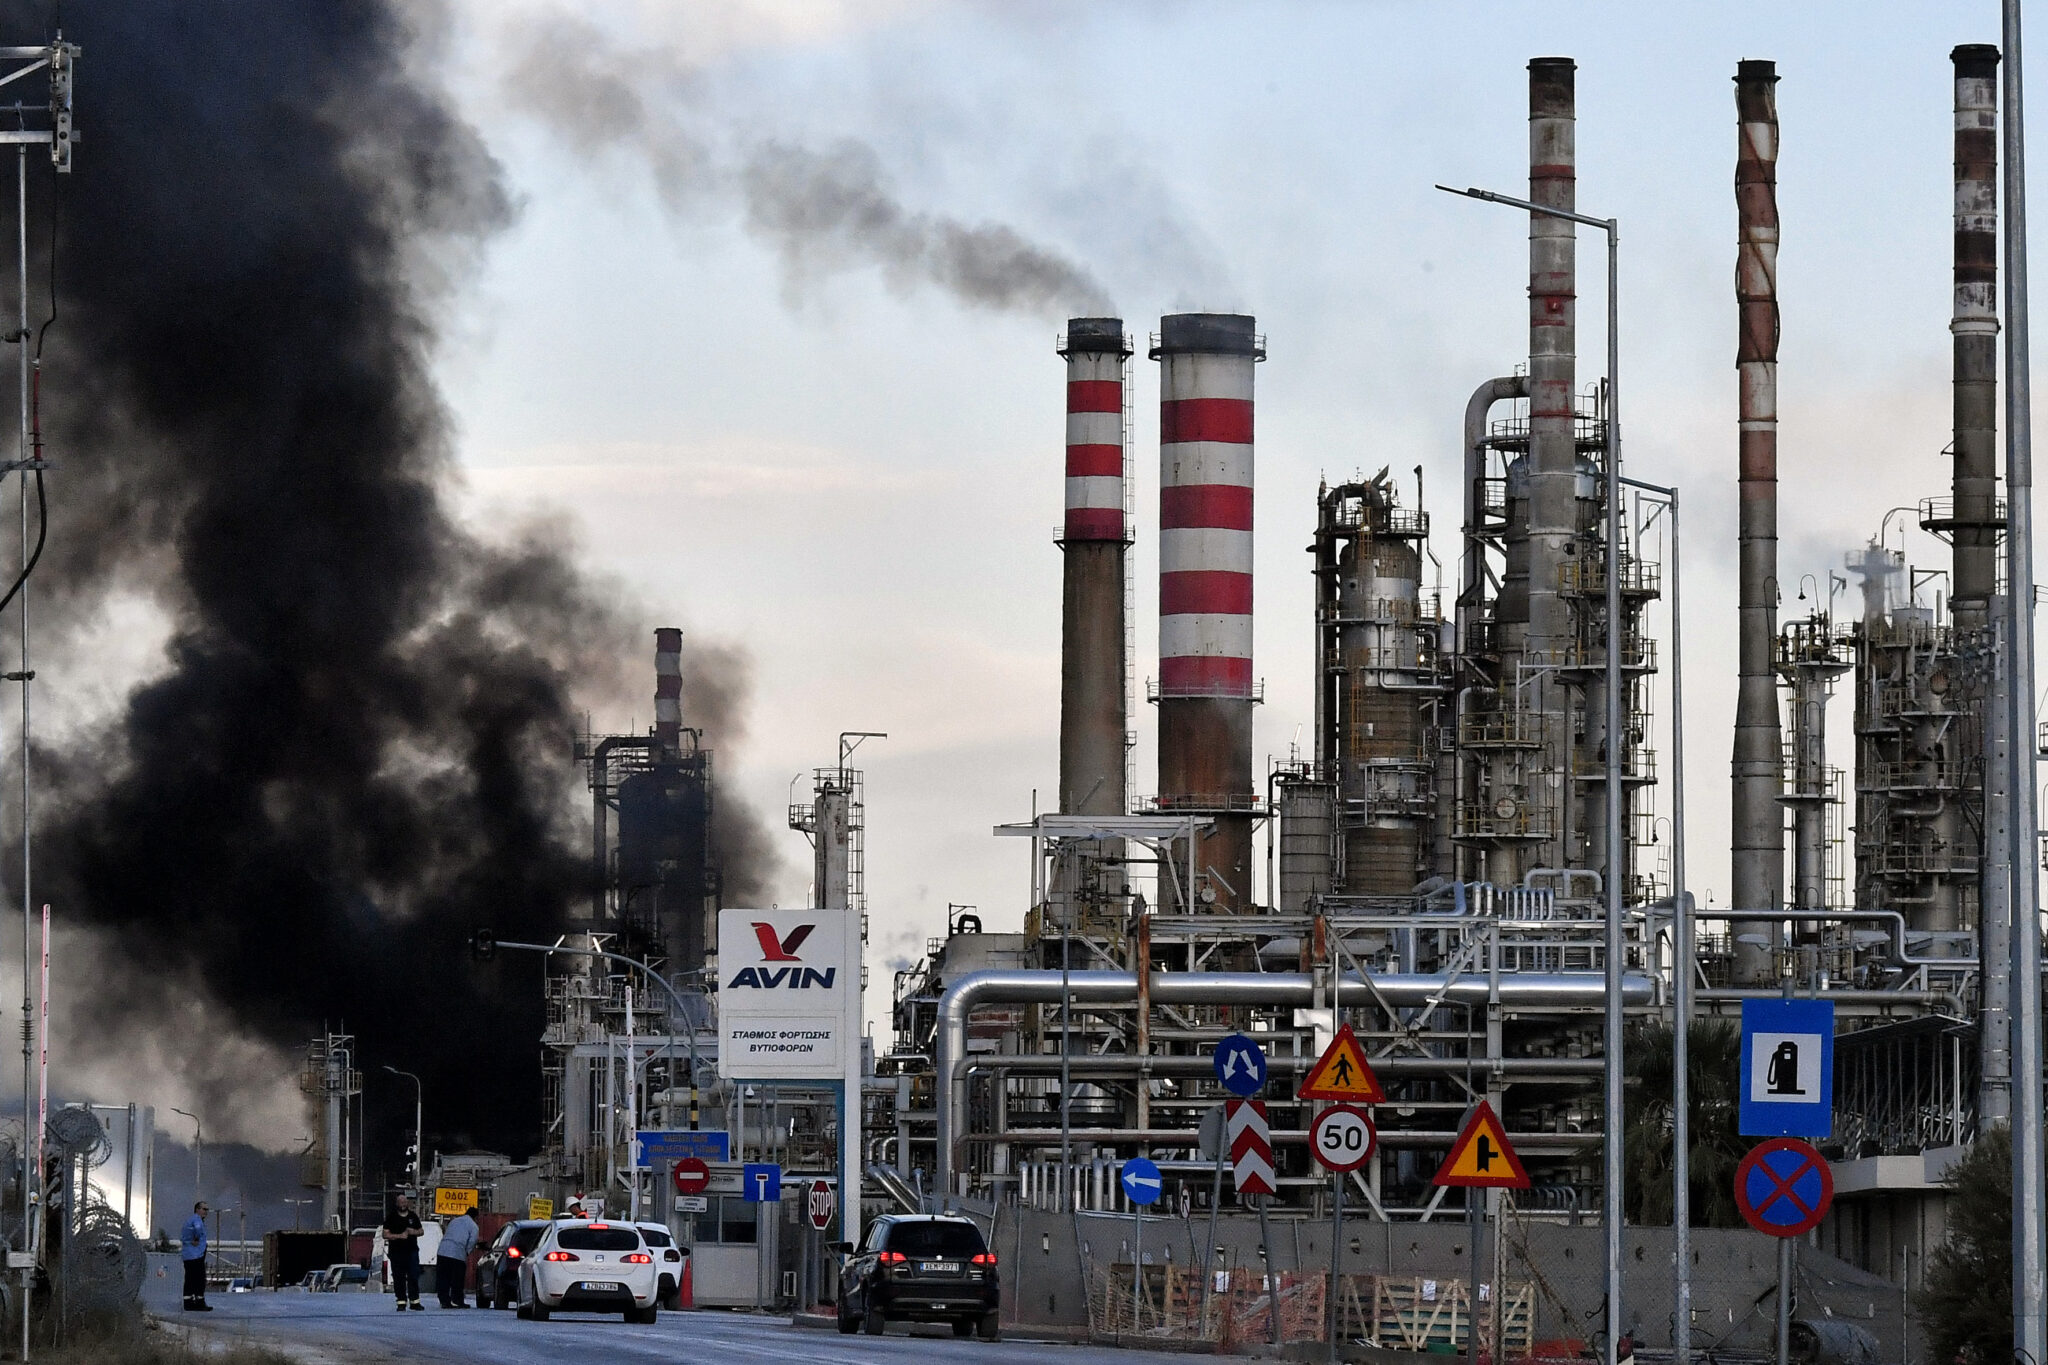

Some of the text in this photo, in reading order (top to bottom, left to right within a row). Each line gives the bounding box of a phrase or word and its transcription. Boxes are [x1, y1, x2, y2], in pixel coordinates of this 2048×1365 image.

[727, 967, 836, 989] AVIN
[732, 1031, 831, 1040] ΣΤΑΘΜΟΣ ΦΟΡΤΩΣΗΣ
[750, 1044, 813, 1052] ΒΥΤΙΟΦΟΡΩΝ
[1323, 1125, 1362, 1151] 50
[444, 1191, 469, 1201] ΟΔΟΣ
[811, 1191, 831, 1216] STOP
